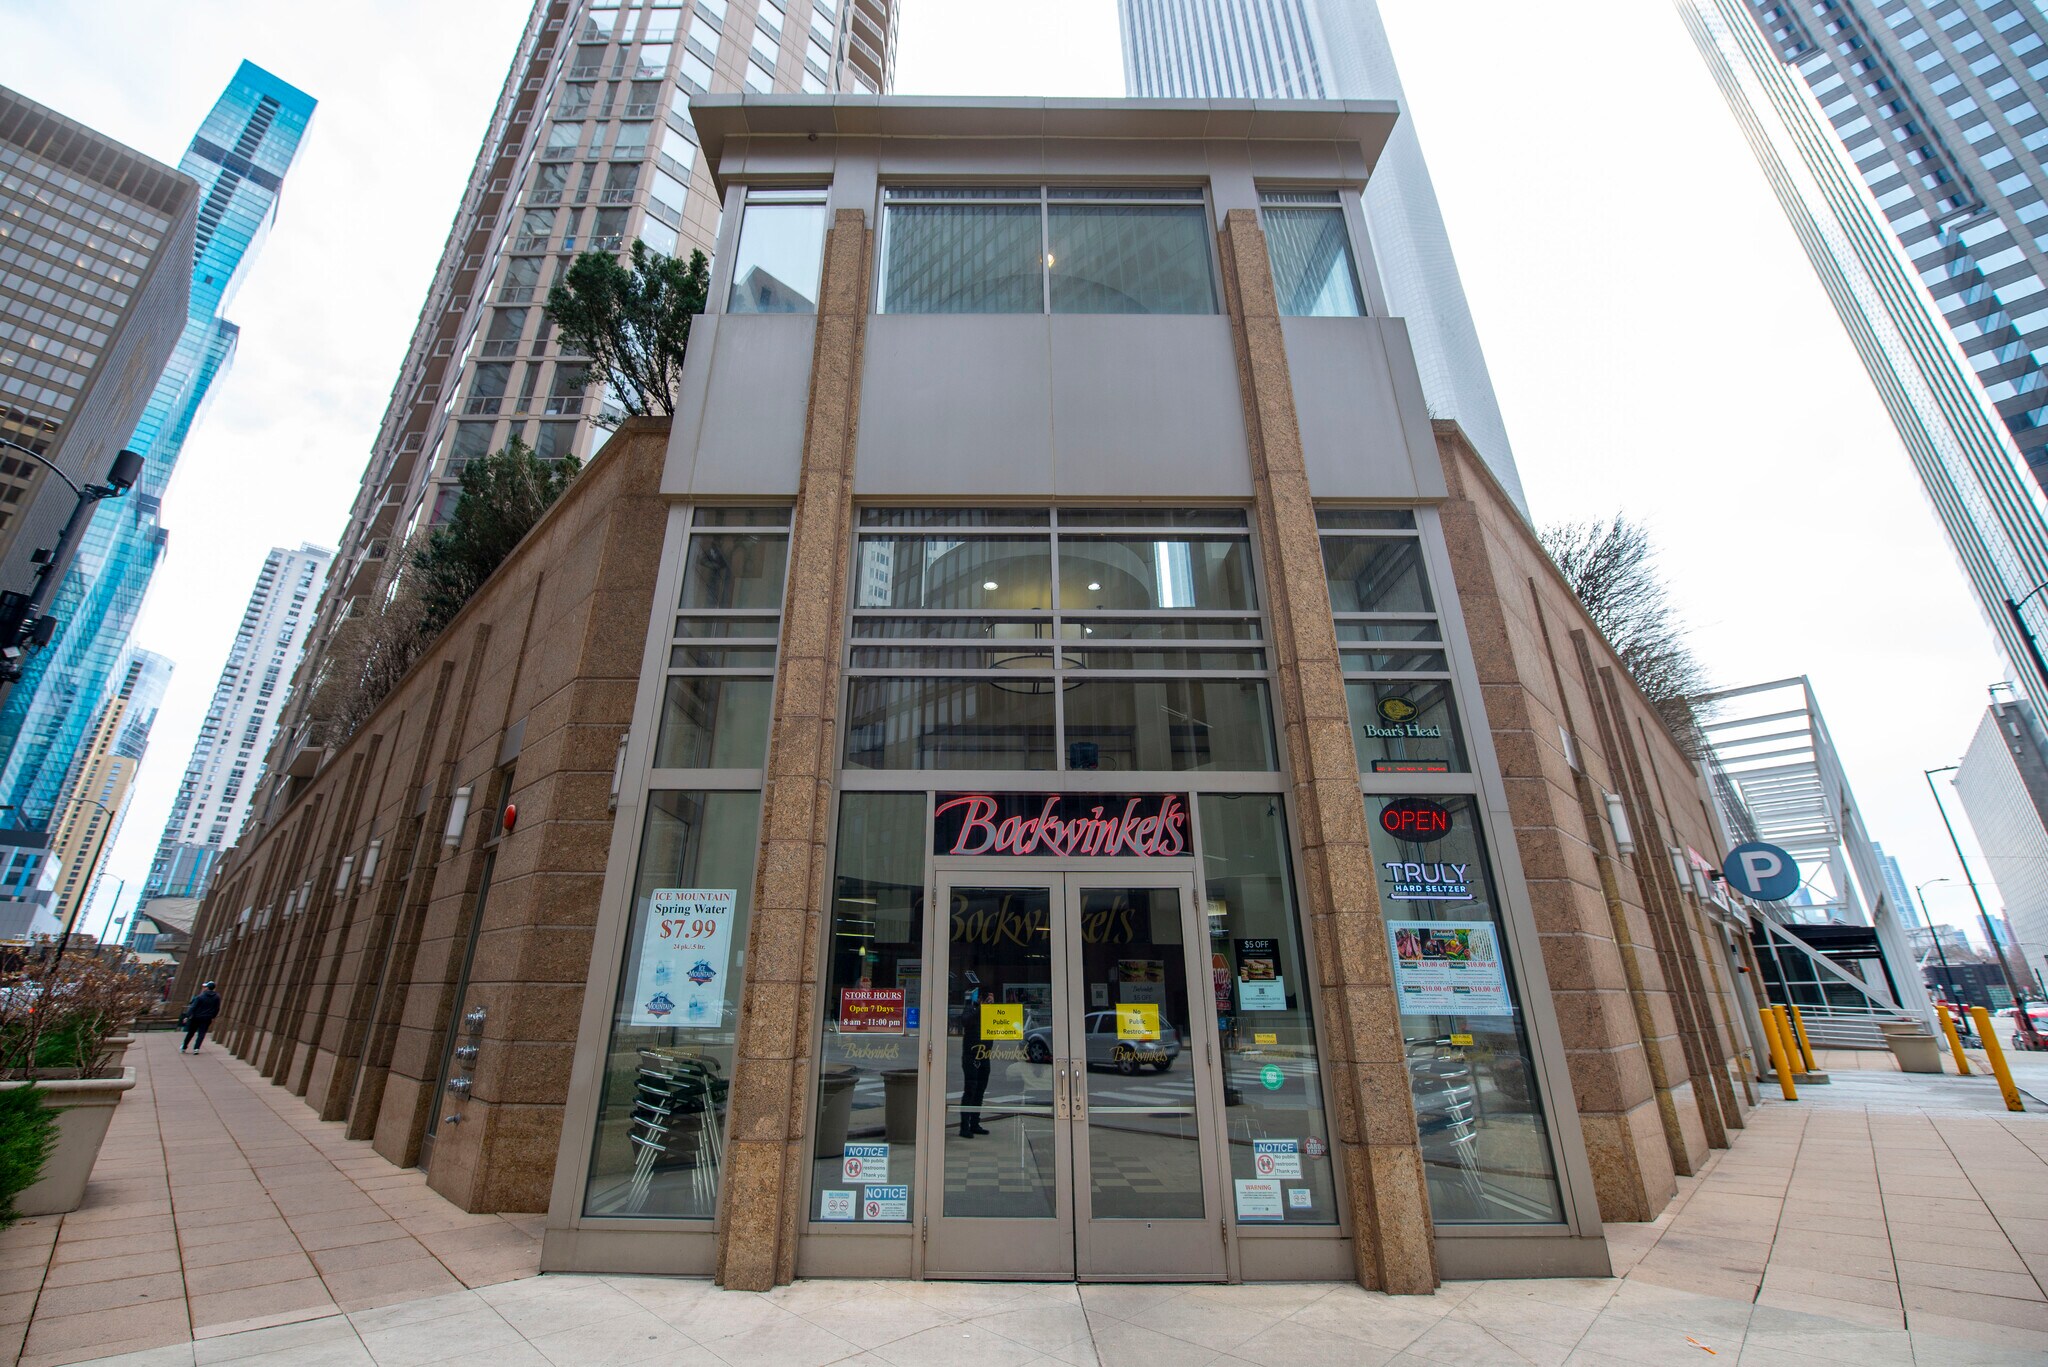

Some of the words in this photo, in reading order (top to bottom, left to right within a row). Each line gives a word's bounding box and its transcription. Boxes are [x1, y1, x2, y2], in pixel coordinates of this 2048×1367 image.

[1366, 724, 1404, 737] Boar's
[1406, 722, 1441, 737] Head
[1384, 810, 1446, 831] OPEN
[936, 795, 1185, 858] Bockwinkel's
[1739, 851, 1782, 892] P
[1394, 884, 1422, 892] HARD
[1426, 884, 1466, 893] SELTZER
[655, 892, 672, 901] ICE
[676, 892, 730, 901] MOUNTAIN
[654, 903, 691, 916] Spring
[694, 904, 727, 914] Water
[660, 919, 716, 939] $7.99
[1244, 940, 1254, 949] $5
[1255, 940, 1269, 949] OFF
[845, 991, 872, 999] STORE
[874, 991, 902, 999] HOURS
[849, 1005, 869, 1014] Open
[876, 1005, 894, 1014] Days
[843, 1018, 849, 1026] 8
[868, 1018, 887, 1026] 11:00
[848, 1147, 884, 1156] NOTICE
[1258, 1143, 1294, 1152] NOTICE
[866, 1188, 906, 1198] NOTICE
